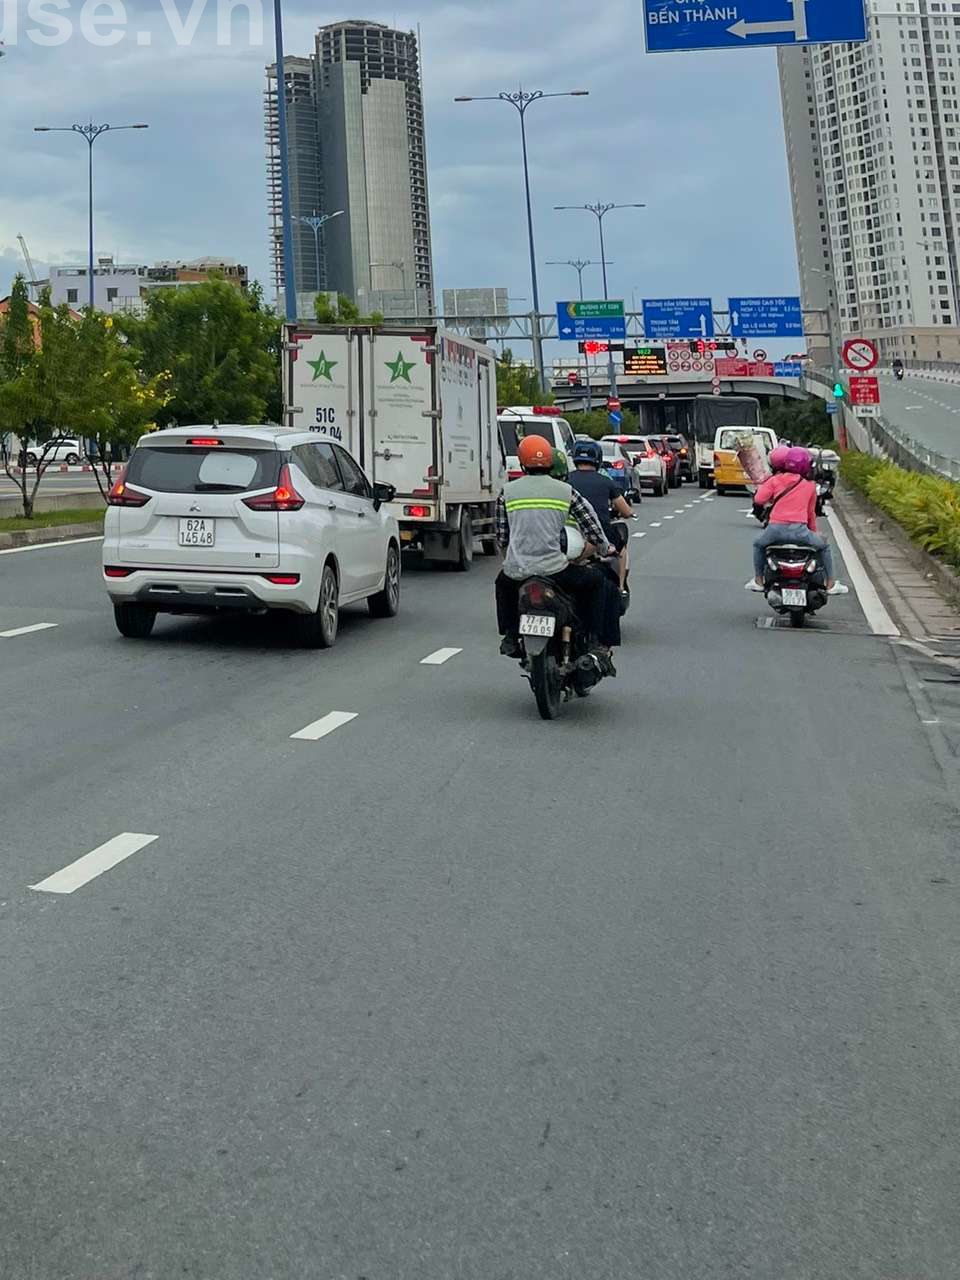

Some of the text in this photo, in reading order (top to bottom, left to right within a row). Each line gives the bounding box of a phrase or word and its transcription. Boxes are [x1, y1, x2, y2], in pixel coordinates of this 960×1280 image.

[648, 6, 738, 25] BẾN THÀNH
[315, 407, 335, 423] 51C
[187, 519, 206, 531] 62A
